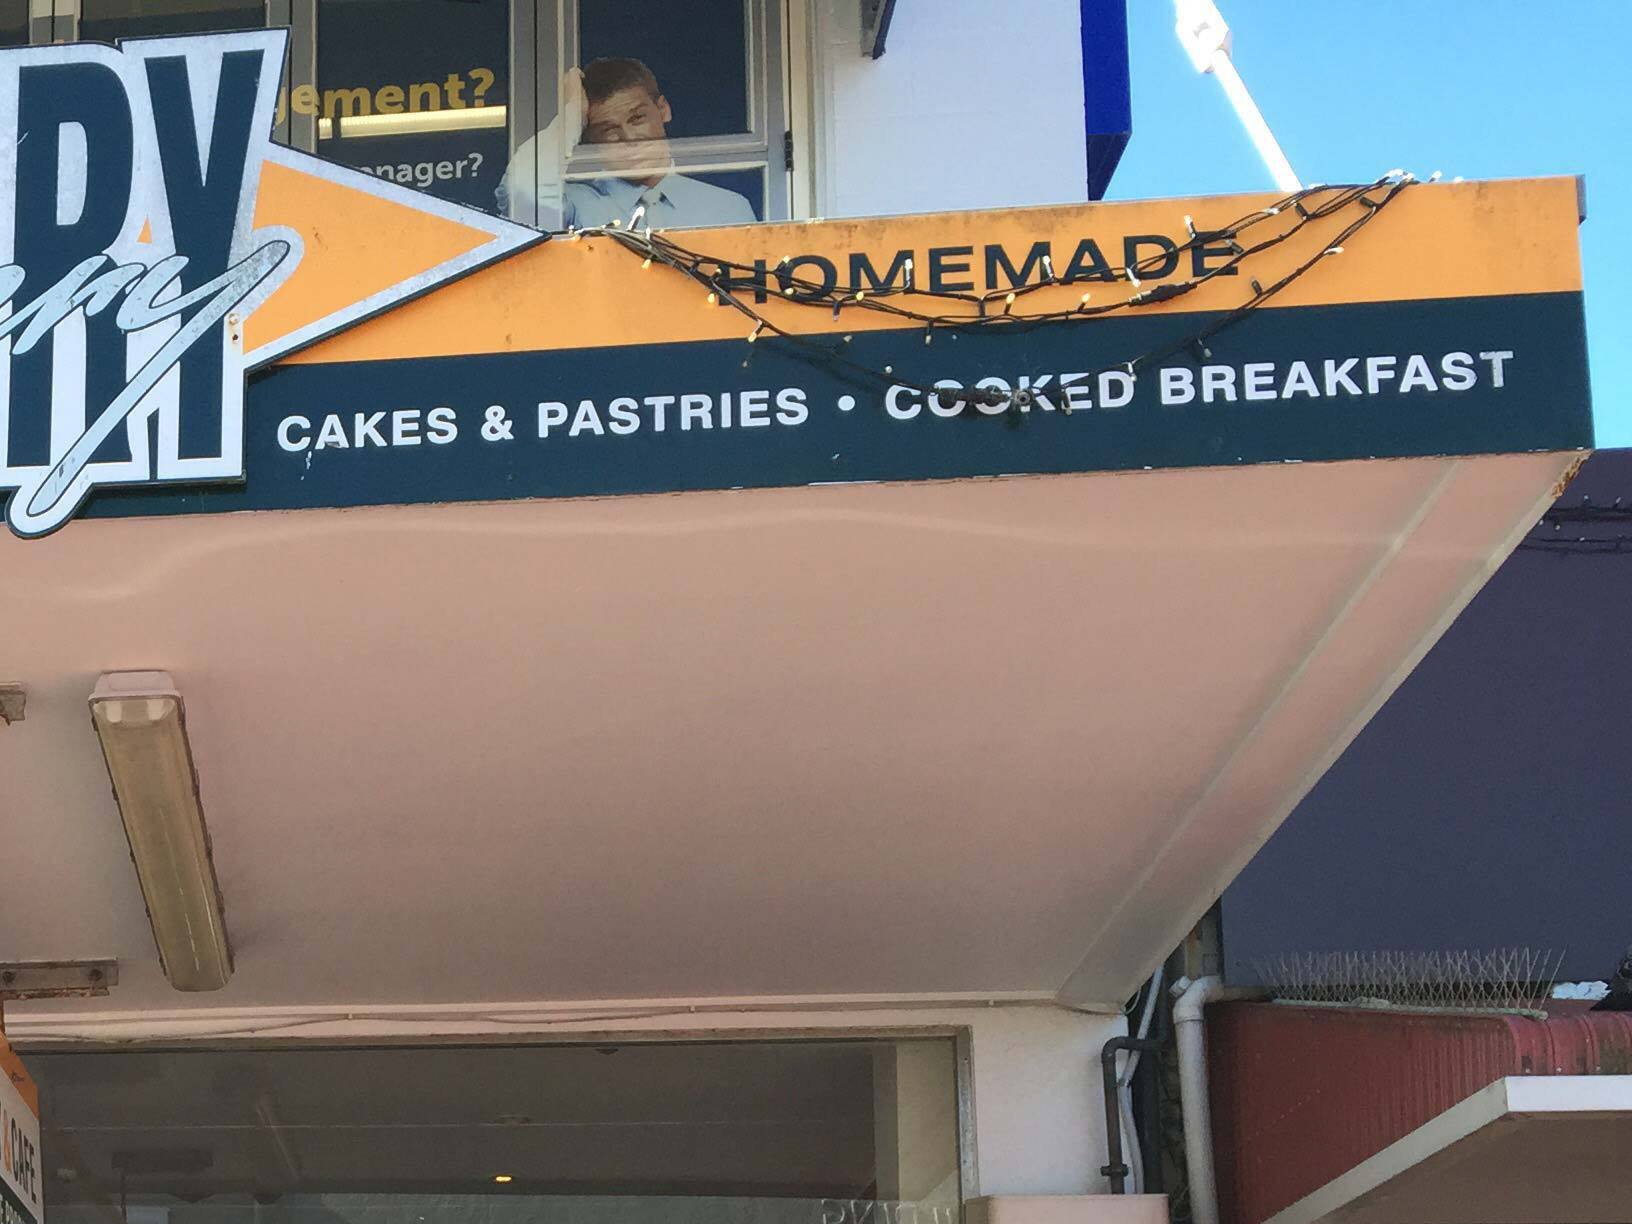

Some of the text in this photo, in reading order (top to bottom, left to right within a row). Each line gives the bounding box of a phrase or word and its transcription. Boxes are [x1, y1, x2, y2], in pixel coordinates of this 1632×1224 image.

[719, 231, 1242, 310] HOMEMADE
[277, 349, 1515, 454] CAKES & PASTRIES COOKED BREAKFAST
[2, 1108, 13, 1174] &
[11, 1116, 38, 1206] CAFE
